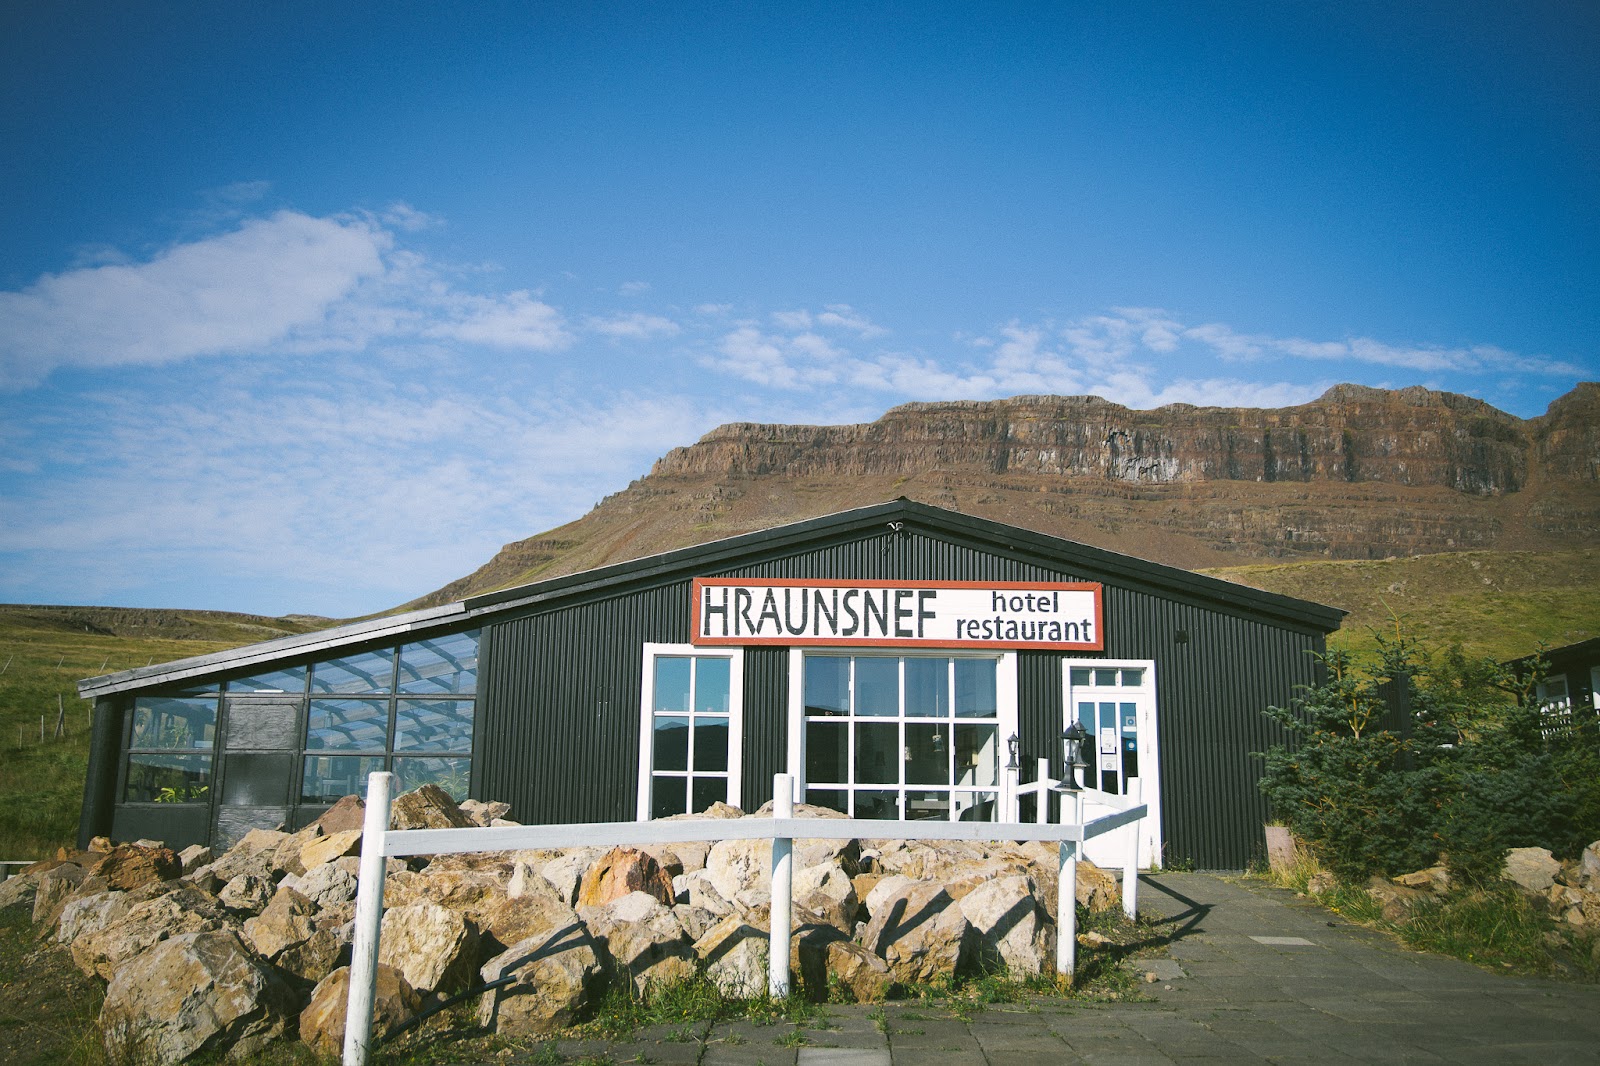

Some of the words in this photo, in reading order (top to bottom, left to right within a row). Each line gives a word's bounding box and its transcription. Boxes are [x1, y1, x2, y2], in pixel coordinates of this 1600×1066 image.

[704, 588, 937, 638] HRAUNSNEF
[992, 591, 1058, 613] hotel
[956, 615, 1092, 642] restaurant
